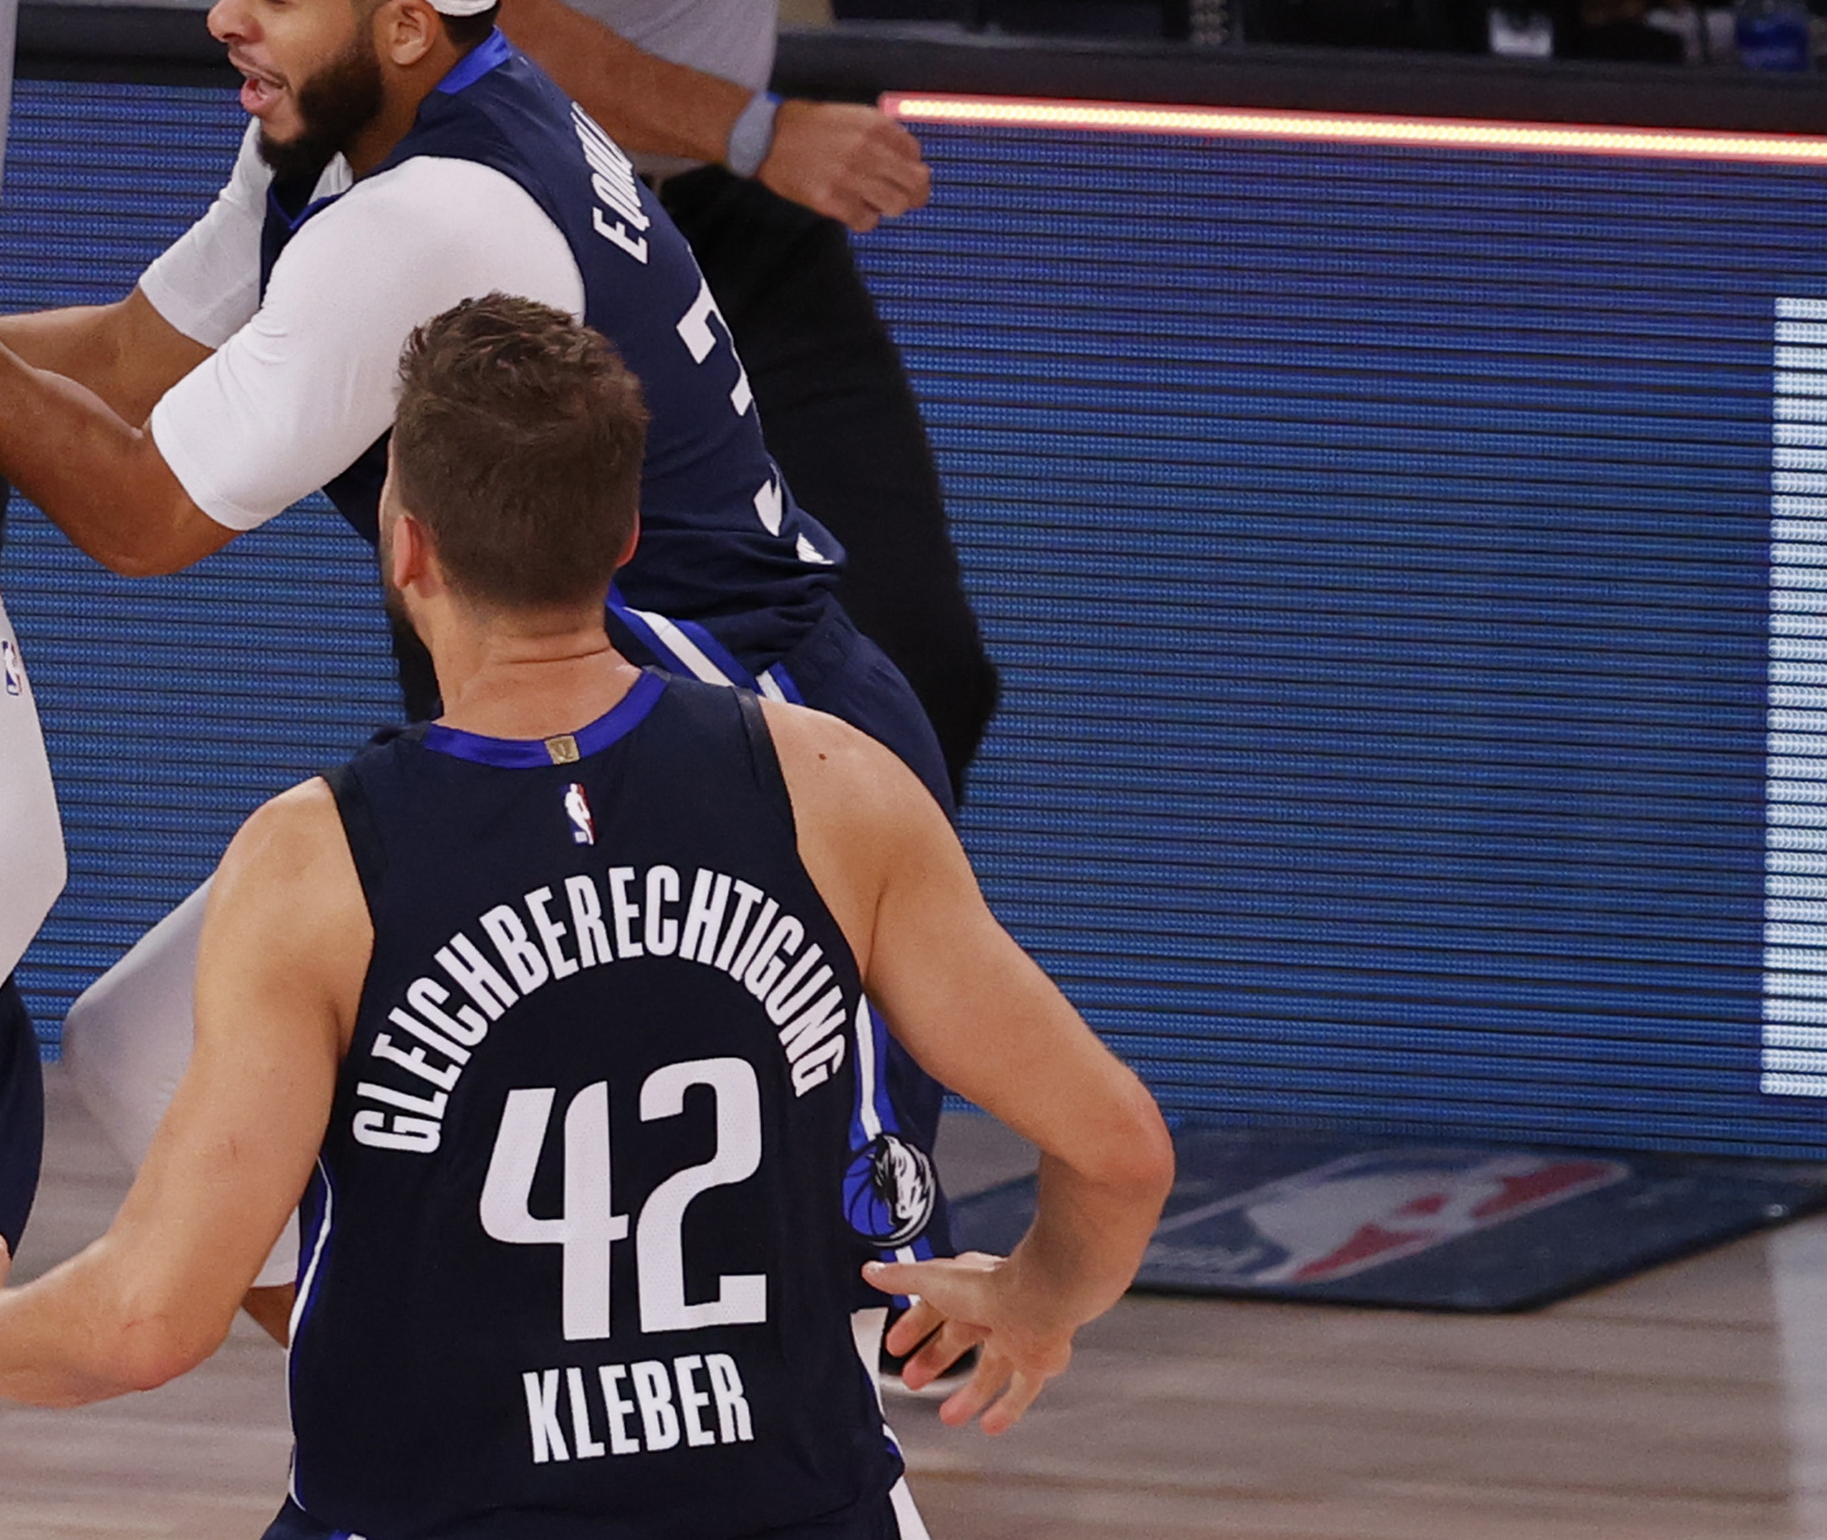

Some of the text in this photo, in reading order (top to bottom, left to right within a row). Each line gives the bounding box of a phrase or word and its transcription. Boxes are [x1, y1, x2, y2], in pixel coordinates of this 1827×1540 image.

[352, 864, 844, 1154] GLEICHBERECHTIGUNG
[479, 1057, 767, 1341] 42
[523, 1352, 753, 1463] KLEBER
